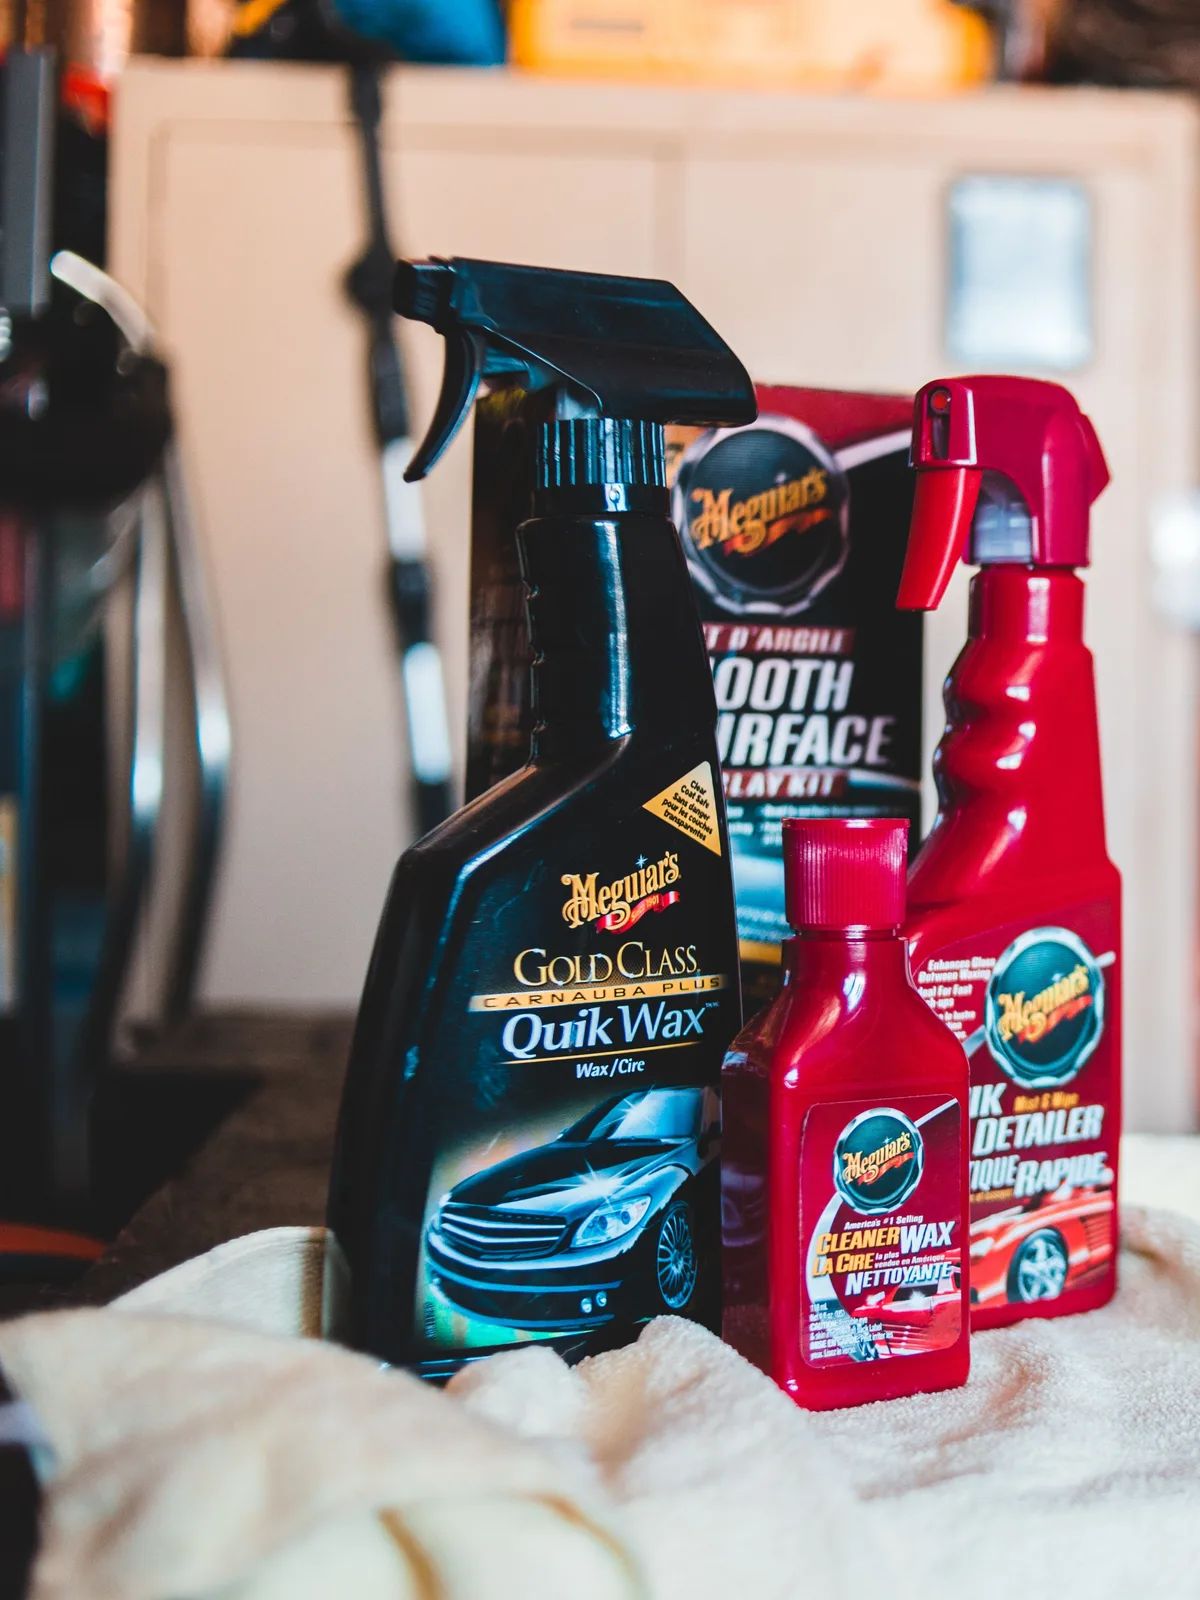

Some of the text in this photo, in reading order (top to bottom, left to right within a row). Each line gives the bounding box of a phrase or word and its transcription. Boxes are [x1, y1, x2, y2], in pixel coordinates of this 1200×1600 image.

[691, 465, 828, 554] Meguiar's
[709, 656, 855, 712] OOTH
[680, 784, 710, 809] Coat Safe
[690, 780, 707, 796] Clear
[722, 772, 835, 797] LAY KIT
[661, 799, 713, 835] pour les couches
[672, 792, 688, 807] Sans
[689, 802, 711, 822] danger
[663, 809, 707, 842] transparentes
[561, 851, 679, 930] Meguiar's
[513, 941, 699, 987] GOLD CLASS
[918, 970, 959, 984] Between
[927, 959, 970, 972] Enhances
[483, 977, 721, 1009] CARNAUBA PLUS
[937, 984, 952, 997] For
[952, 983, 973, 997] Fast
[997, 964, 1090, 1042] Meguiar's
[502, 1001, 706, 1060] Quik Wax
[575, 1058, 646, 1079] Wax/Cire
[970, 1082, 1007, 1118] IK
[972, 1104, 1105, 1157] DETAILER
[842, 1131, 911, 1185] Meguiar's
[816, 1220, 956, 1256] CLEANER WAX
[844, 1214, 924, 1231] America's #1 Selling
[811, 1252, 875, 1278] LA CIRE
[874, 1254, 945, 1269] vendue en Amérique
[875, 1251, 900, 1262] la plus
[844, 1261, 952, 1296] NETTOYANTE
